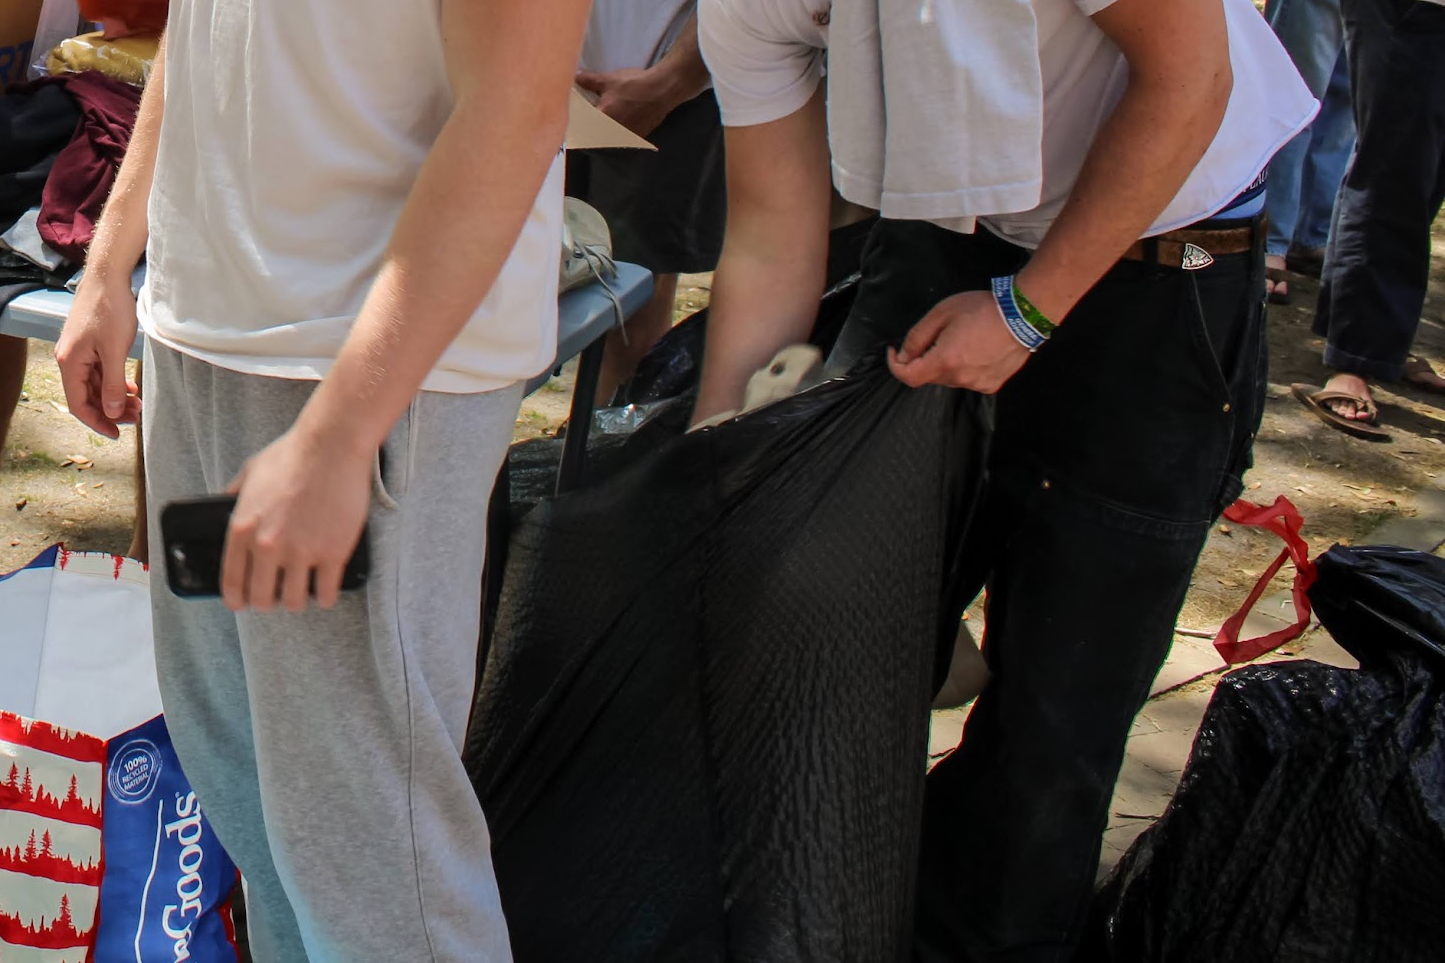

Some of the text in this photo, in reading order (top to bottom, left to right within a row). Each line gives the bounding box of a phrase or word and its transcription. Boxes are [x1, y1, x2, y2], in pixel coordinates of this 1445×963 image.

[123, 755, 148, 773] 100%
[122, 764, 149, 784] RECYCLED
[123, 773, 150, 791] MATERIAL
